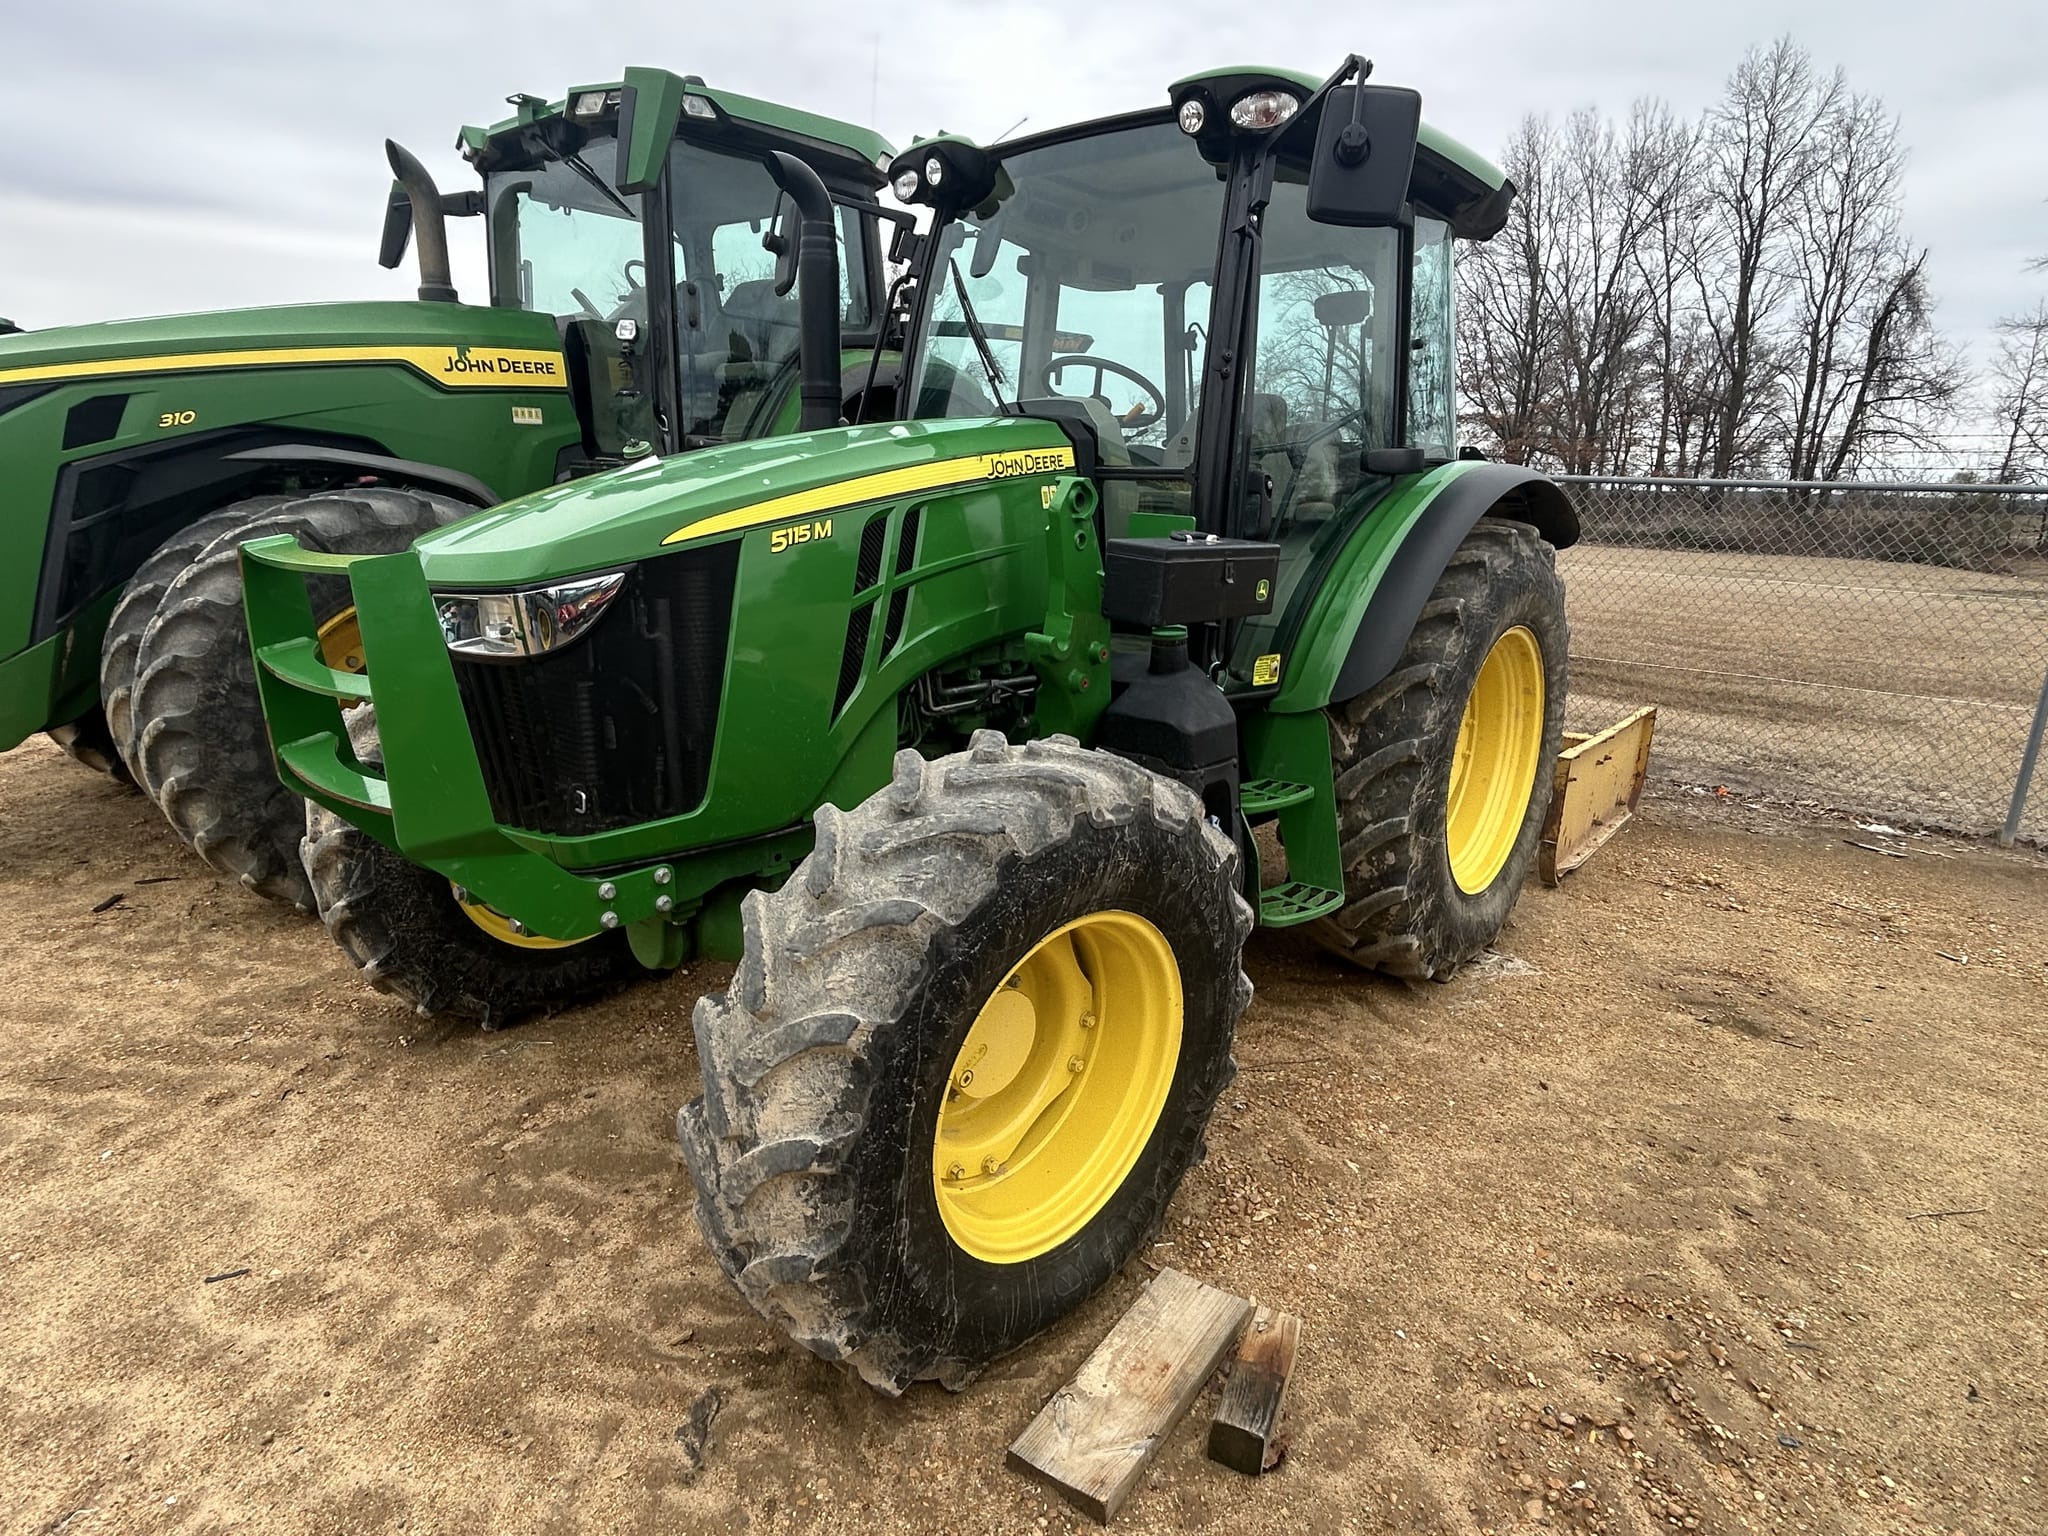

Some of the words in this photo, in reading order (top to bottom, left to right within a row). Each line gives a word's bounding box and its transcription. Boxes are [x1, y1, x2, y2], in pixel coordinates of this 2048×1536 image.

[444, 356, 495, 373] JOHN
[497, 357, 556, 375] DEERE
[159, 410, 196, 427] 310
[987, 458, 1024, 477] JOHN
[1024, 454, 1065, 472] DEERE
